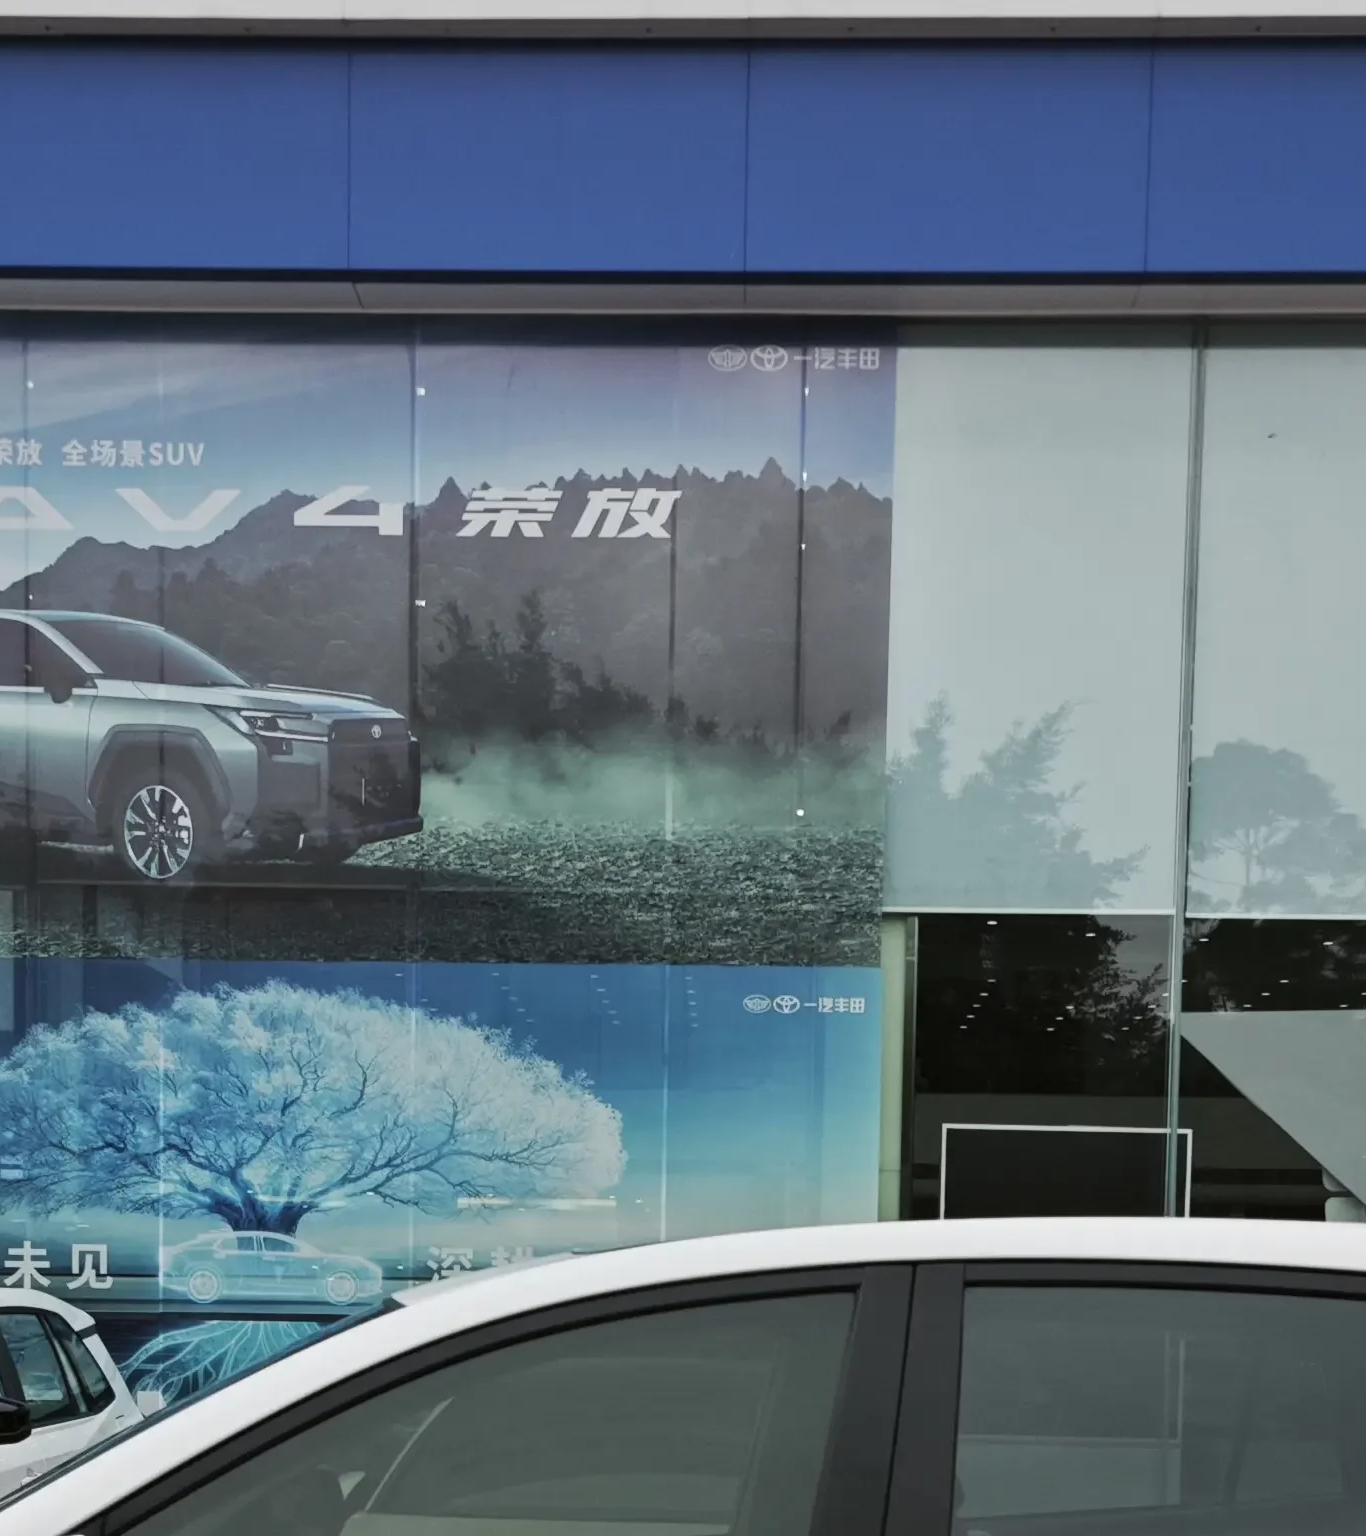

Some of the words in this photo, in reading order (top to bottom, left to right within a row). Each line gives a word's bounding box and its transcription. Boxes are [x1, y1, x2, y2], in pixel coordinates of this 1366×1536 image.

[793, 347, 880, 370] 一汽丰田
[62, 440, 205, 467] 全场景SUV
[455, 488, 682, 539] 荣放
[803, 997, 865, 1013] 一汽丰田
